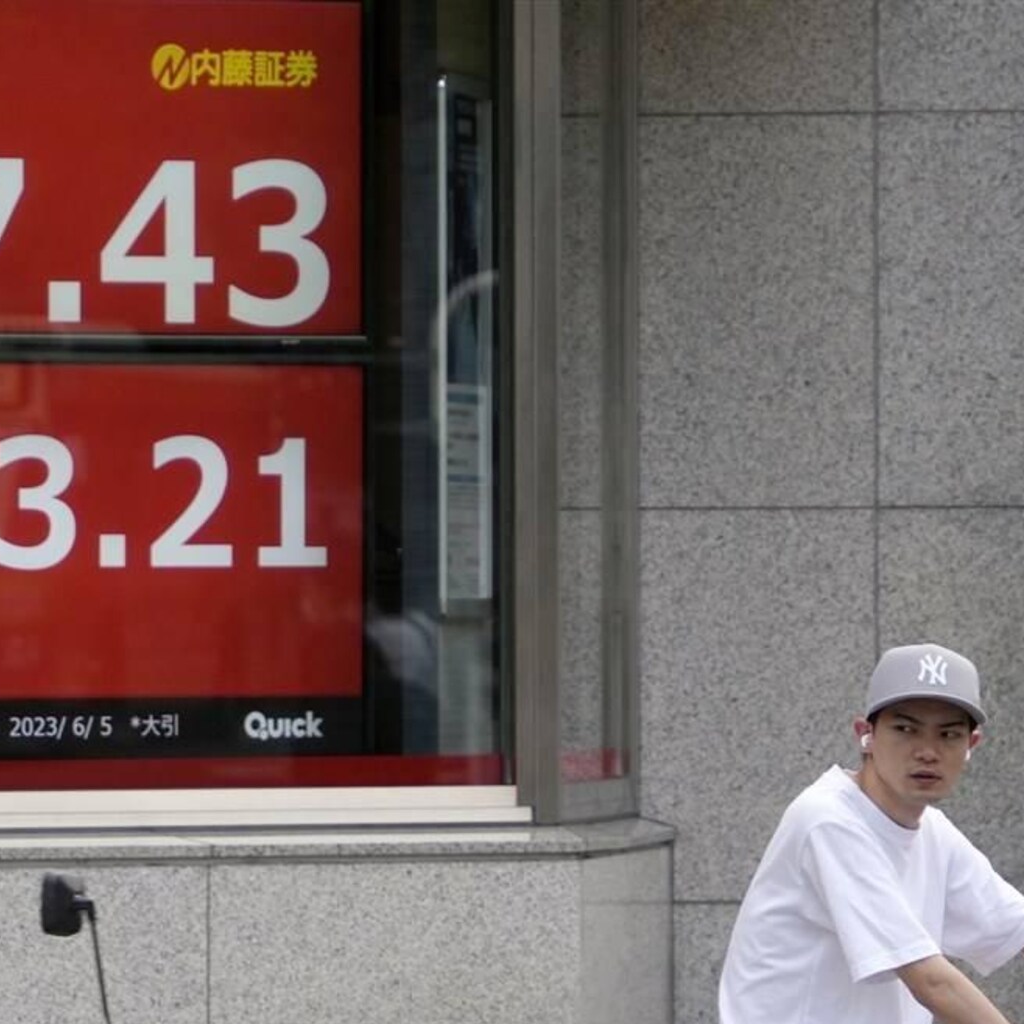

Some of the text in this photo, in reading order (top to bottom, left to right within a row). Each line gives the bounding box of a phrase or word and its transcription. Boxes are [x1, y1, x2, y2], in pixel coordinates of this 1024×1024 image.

[189, 48, 318, 88] 内藤証券
[917, 653, 949, 686] NY
[9, 715, 68, 740] 2023/
